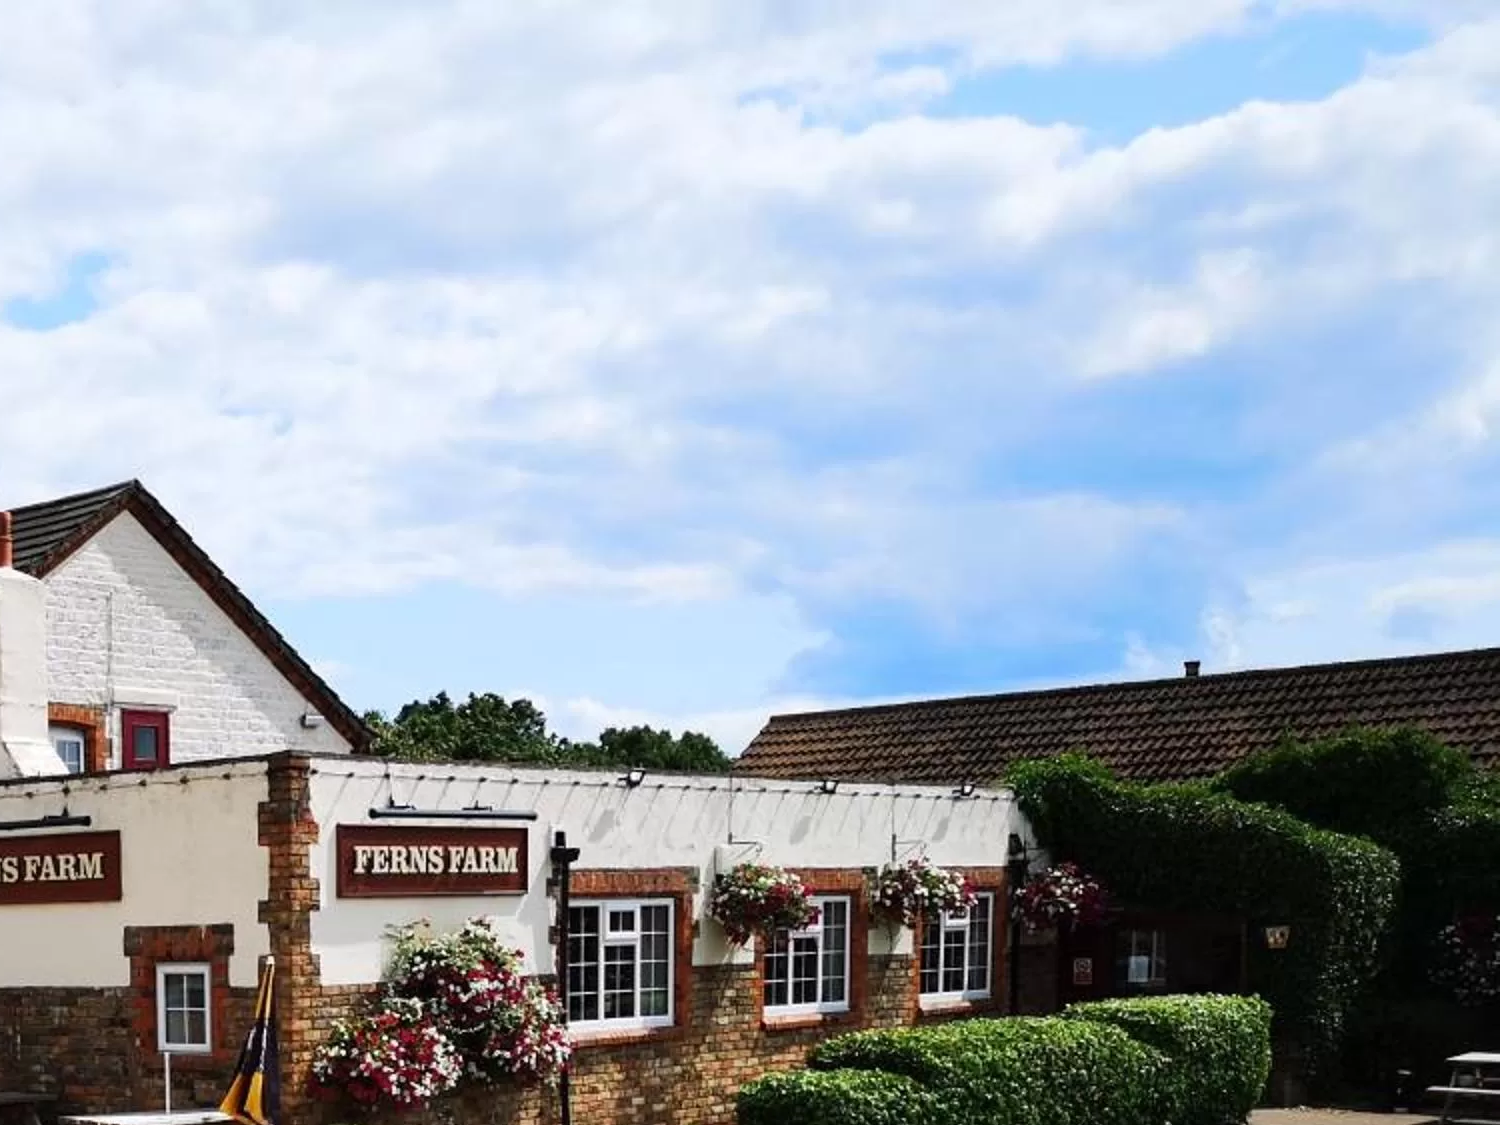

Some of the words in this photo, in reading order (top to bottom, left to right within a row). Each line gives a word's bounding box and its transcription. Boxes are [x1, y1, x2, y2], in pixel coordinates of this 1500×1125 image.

[23, 852, 105, 881] FARM
[353, 845, 445, 875] FERNS
[447, 846, 519, 874] FARM
